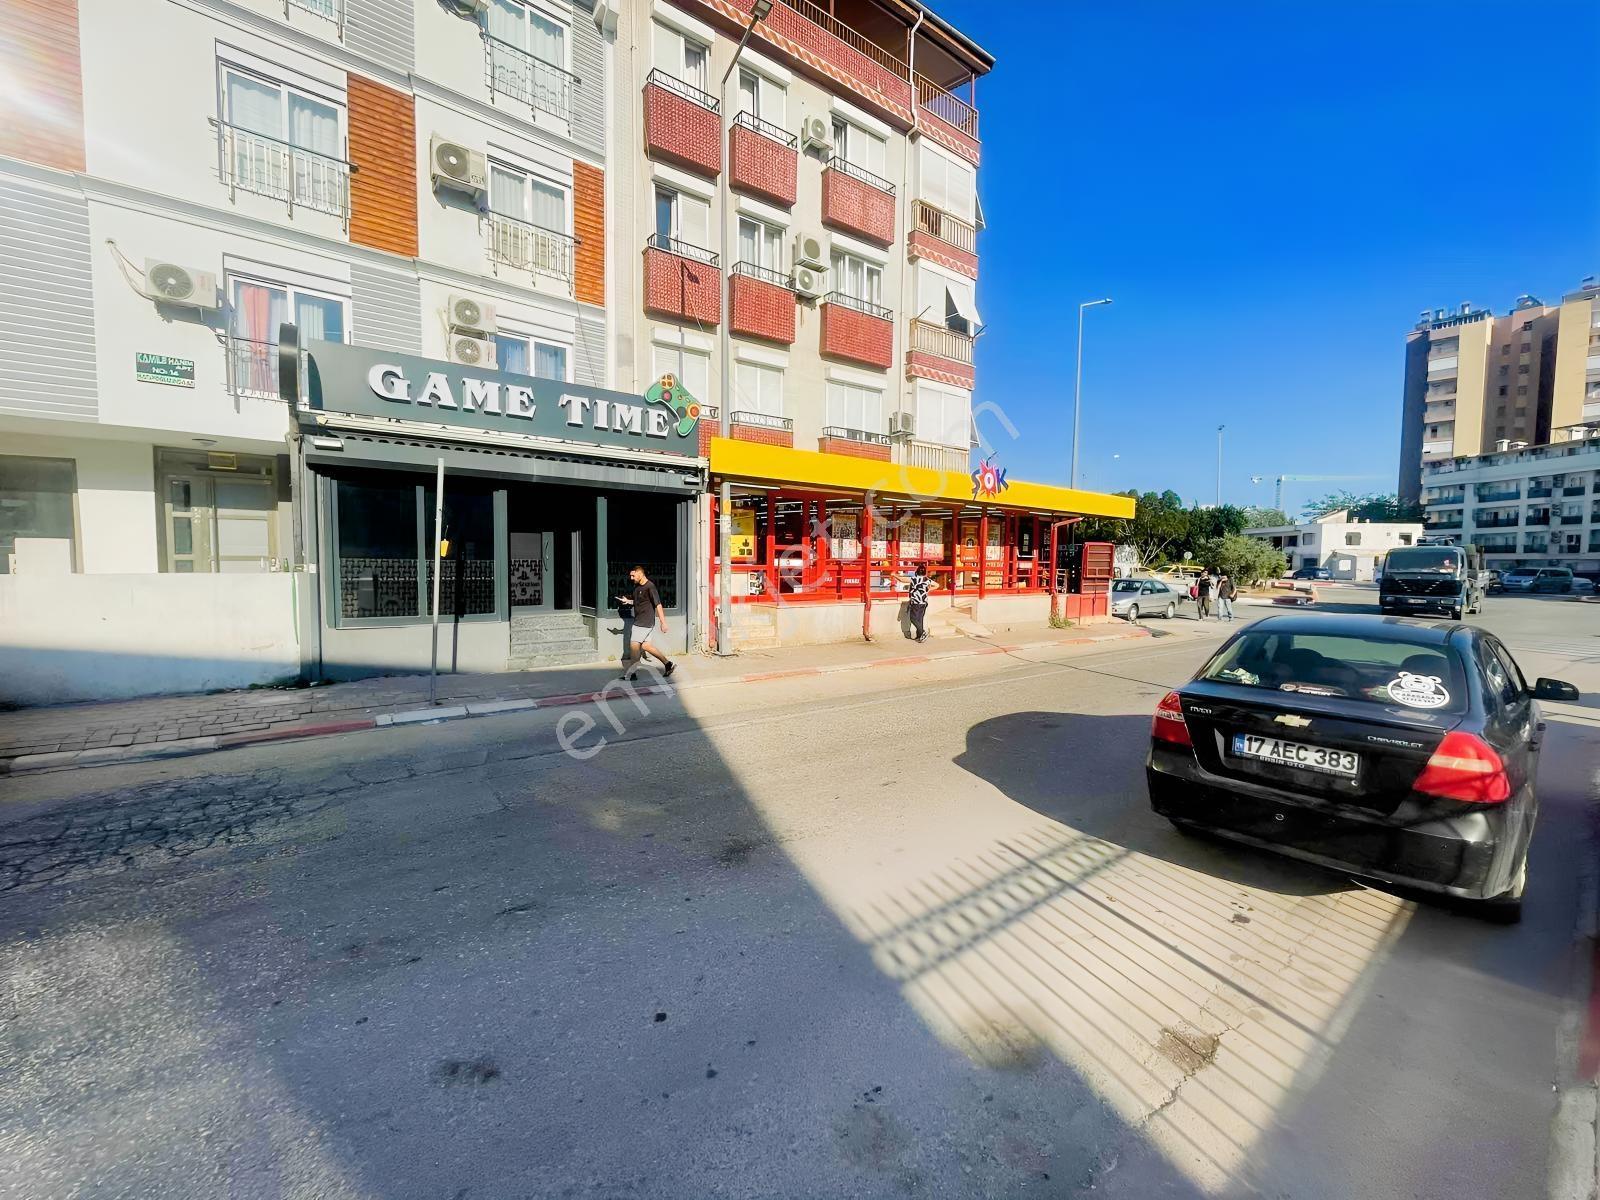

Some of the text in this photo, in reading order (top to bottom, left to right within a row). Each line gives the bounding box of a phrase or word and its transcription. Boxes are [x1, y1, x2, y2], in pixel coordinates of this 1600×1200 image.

[368, 363, 671, 439] GAME TIME
[1246, 735, 1266, 754] 17
[1269, 740, 1309, 760] AEC
[1314, 750, 1356, 771] 383
